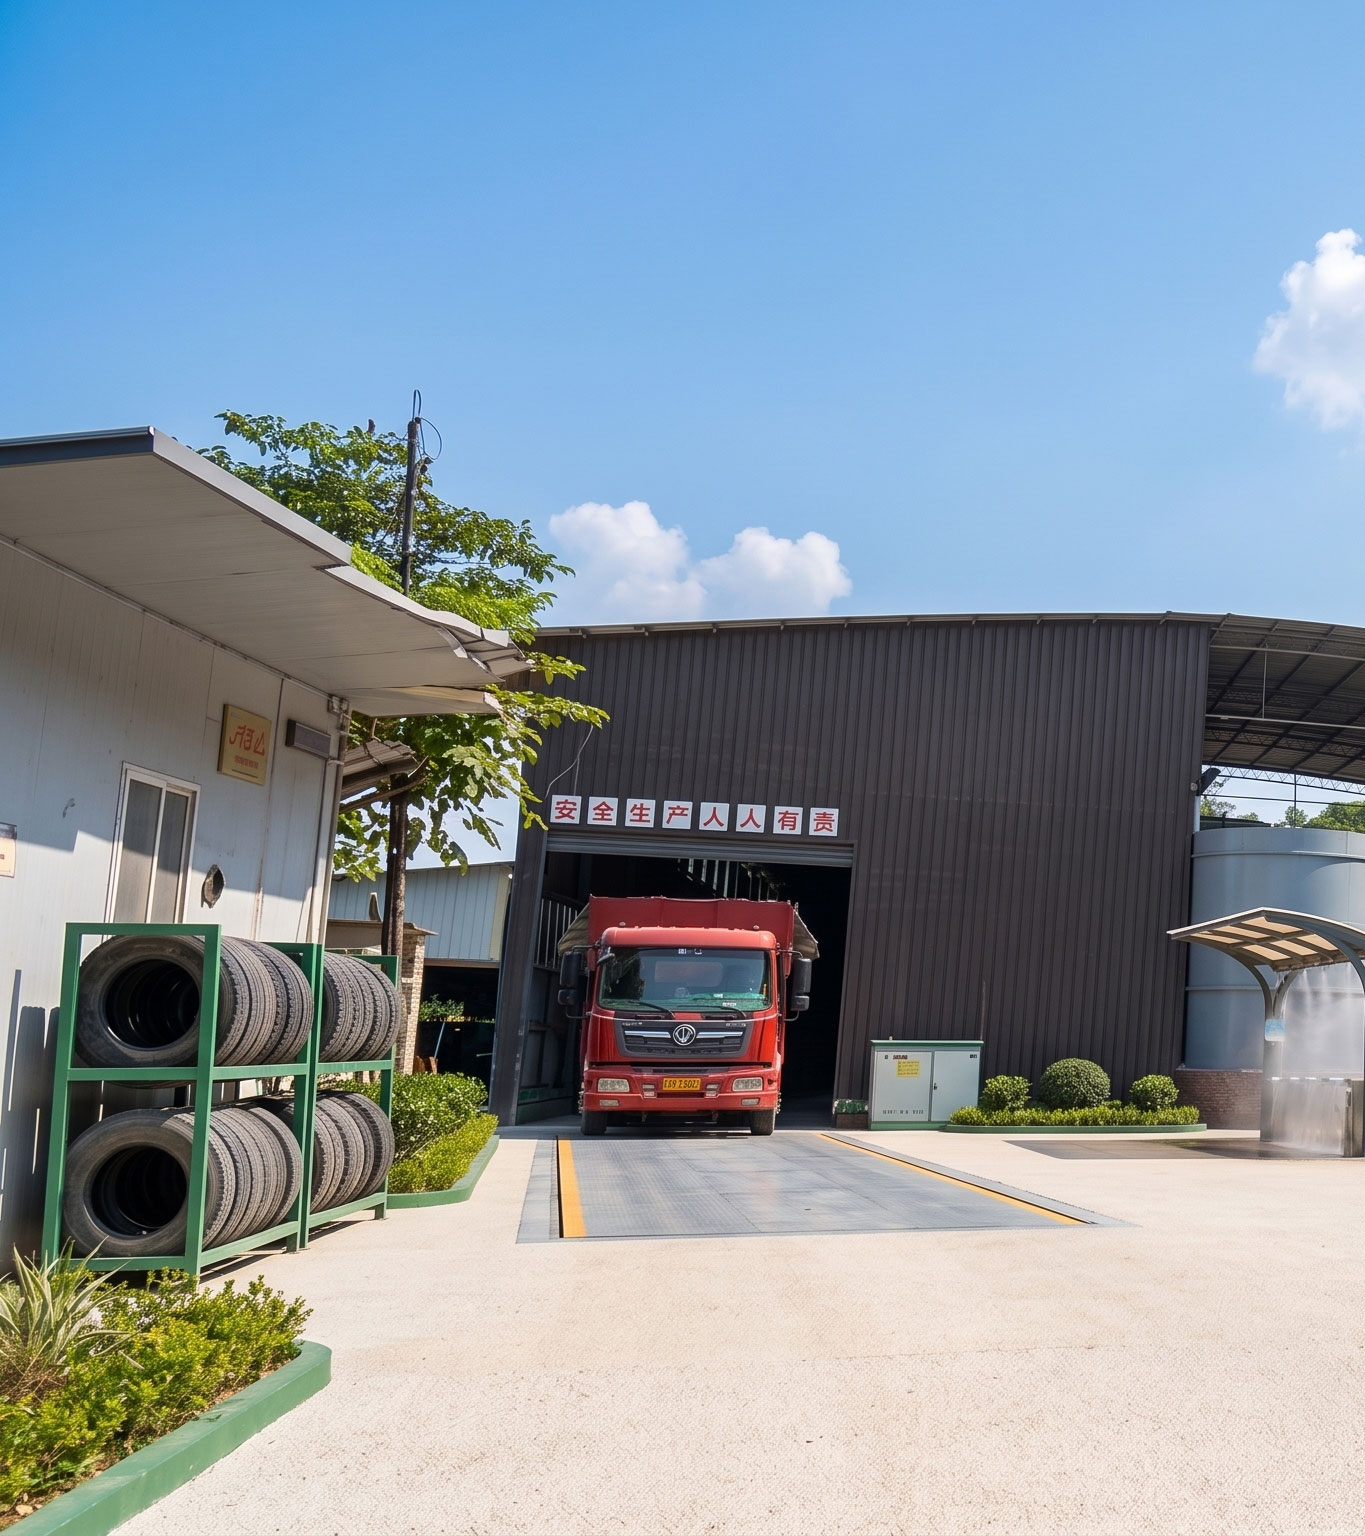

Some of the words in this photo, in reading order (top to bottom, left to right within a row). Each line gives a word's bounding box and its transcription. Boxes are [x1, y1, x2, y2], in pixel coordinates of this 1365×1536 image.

[554, 799, 835, 833] 安全生产人人有责
